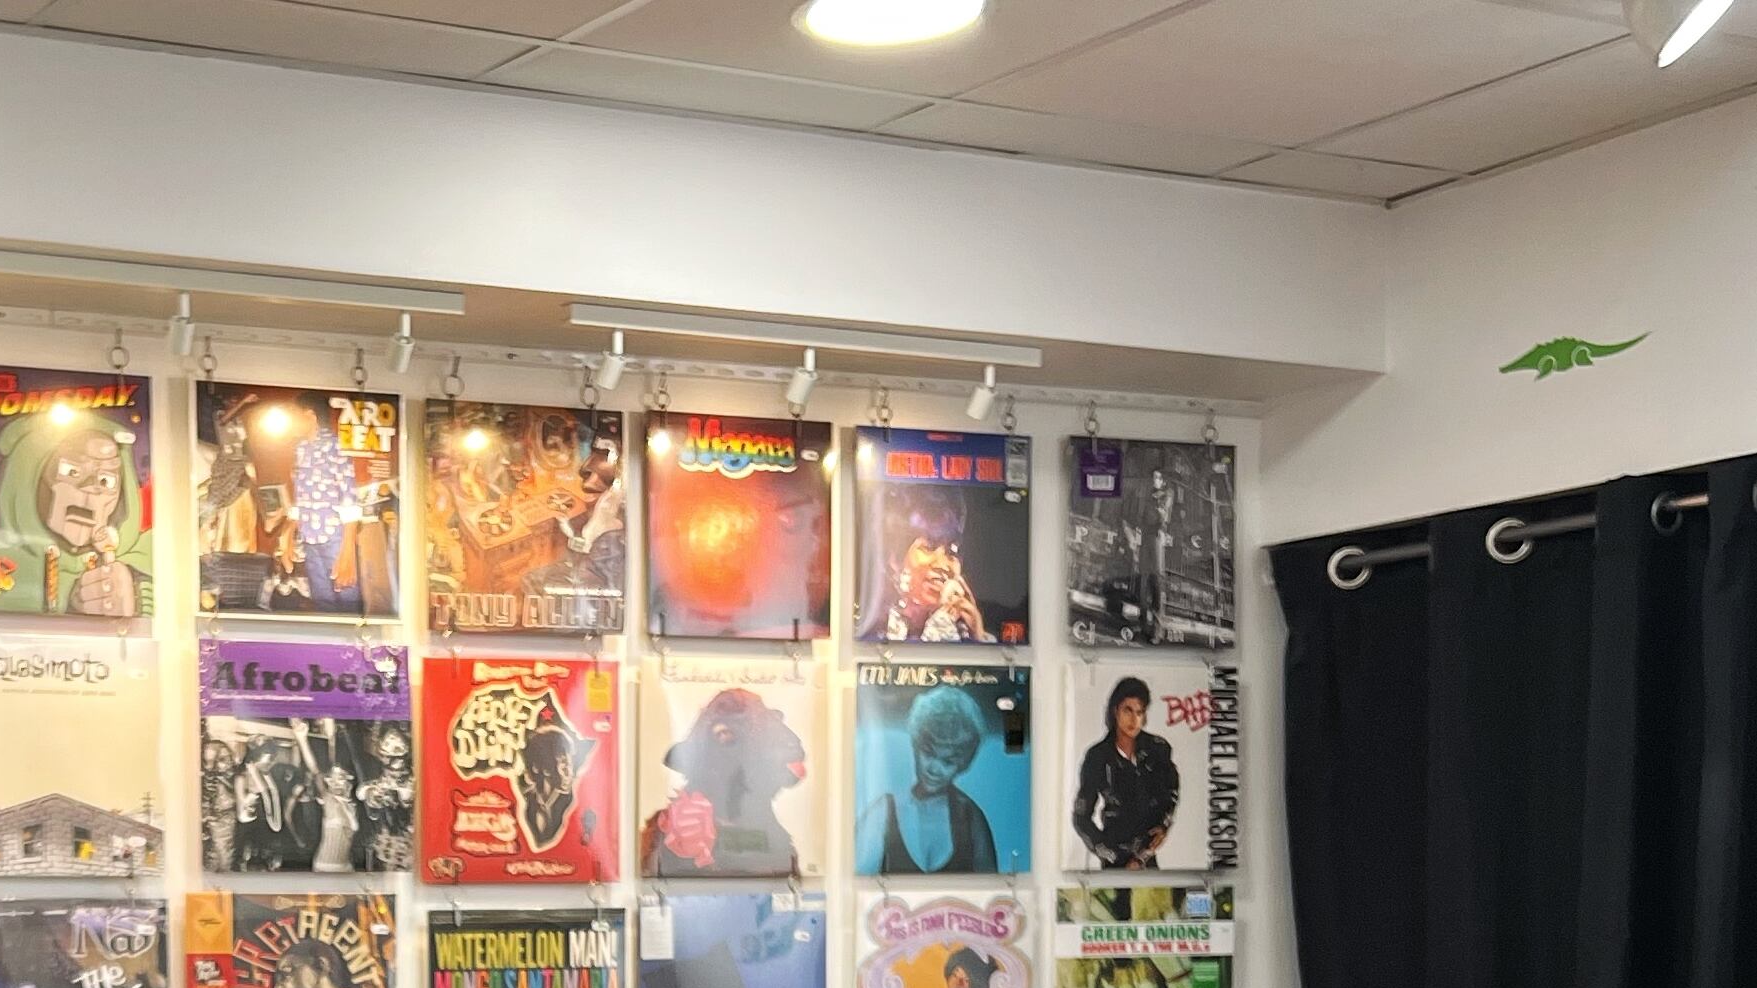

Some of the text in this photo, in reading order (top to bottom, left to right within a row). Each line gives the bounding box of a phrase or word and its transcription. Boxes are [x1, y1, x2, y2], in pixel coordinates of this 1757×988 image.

[1208, 666, 1239, 869] MICHAEL JACKSON
[434, 928, 619, 971] WATERMELON MAN!
[1081, 924, 1211, 942] GREEN ONIONS
